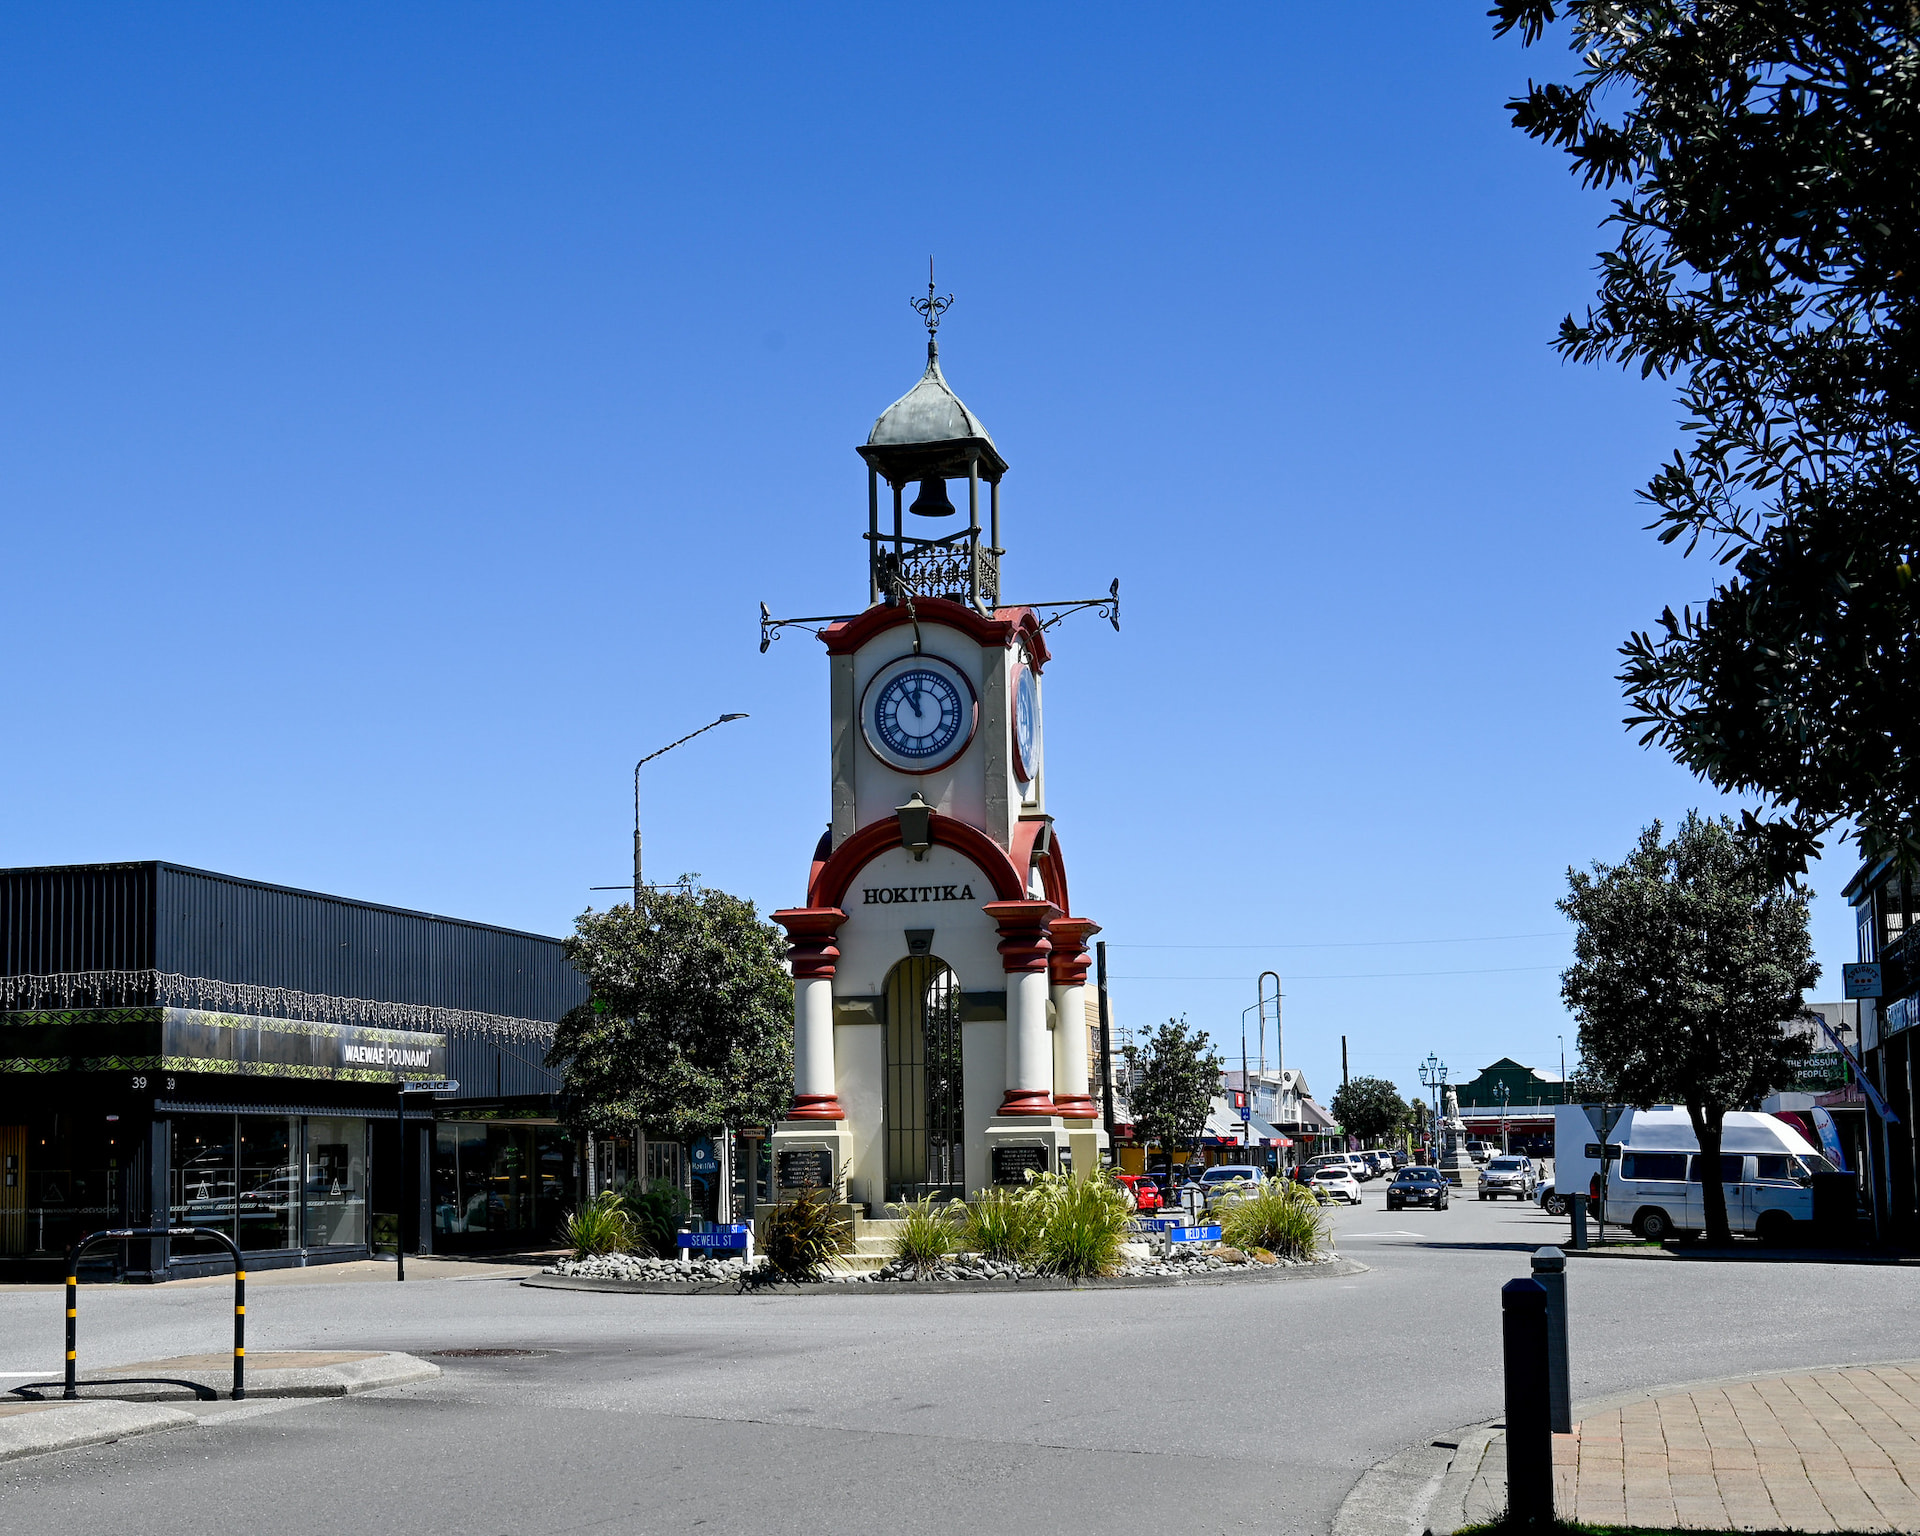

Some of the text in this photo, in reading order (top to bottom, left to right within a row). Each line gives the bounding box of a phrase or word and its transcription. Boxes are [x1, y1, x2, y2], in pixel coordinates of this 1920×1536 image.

[862, 884, 976, 905] HOKITIKA
[344, 1045, 430, 1068] WAEWAE POUNAMU
[1803, 1058, 1838, 1067] POSSUM
[1797, 1069, 1828, 1079] PEOPLE
[132, 1076, 148, 1089] 39
[166, 1077, 176, 1090] 39
[415, 1081, 450, 1091] POLICE
[1185, 1227, 1209, 1240] WELD ST
[691, 1234, 732, 1247] SEWELL ST
